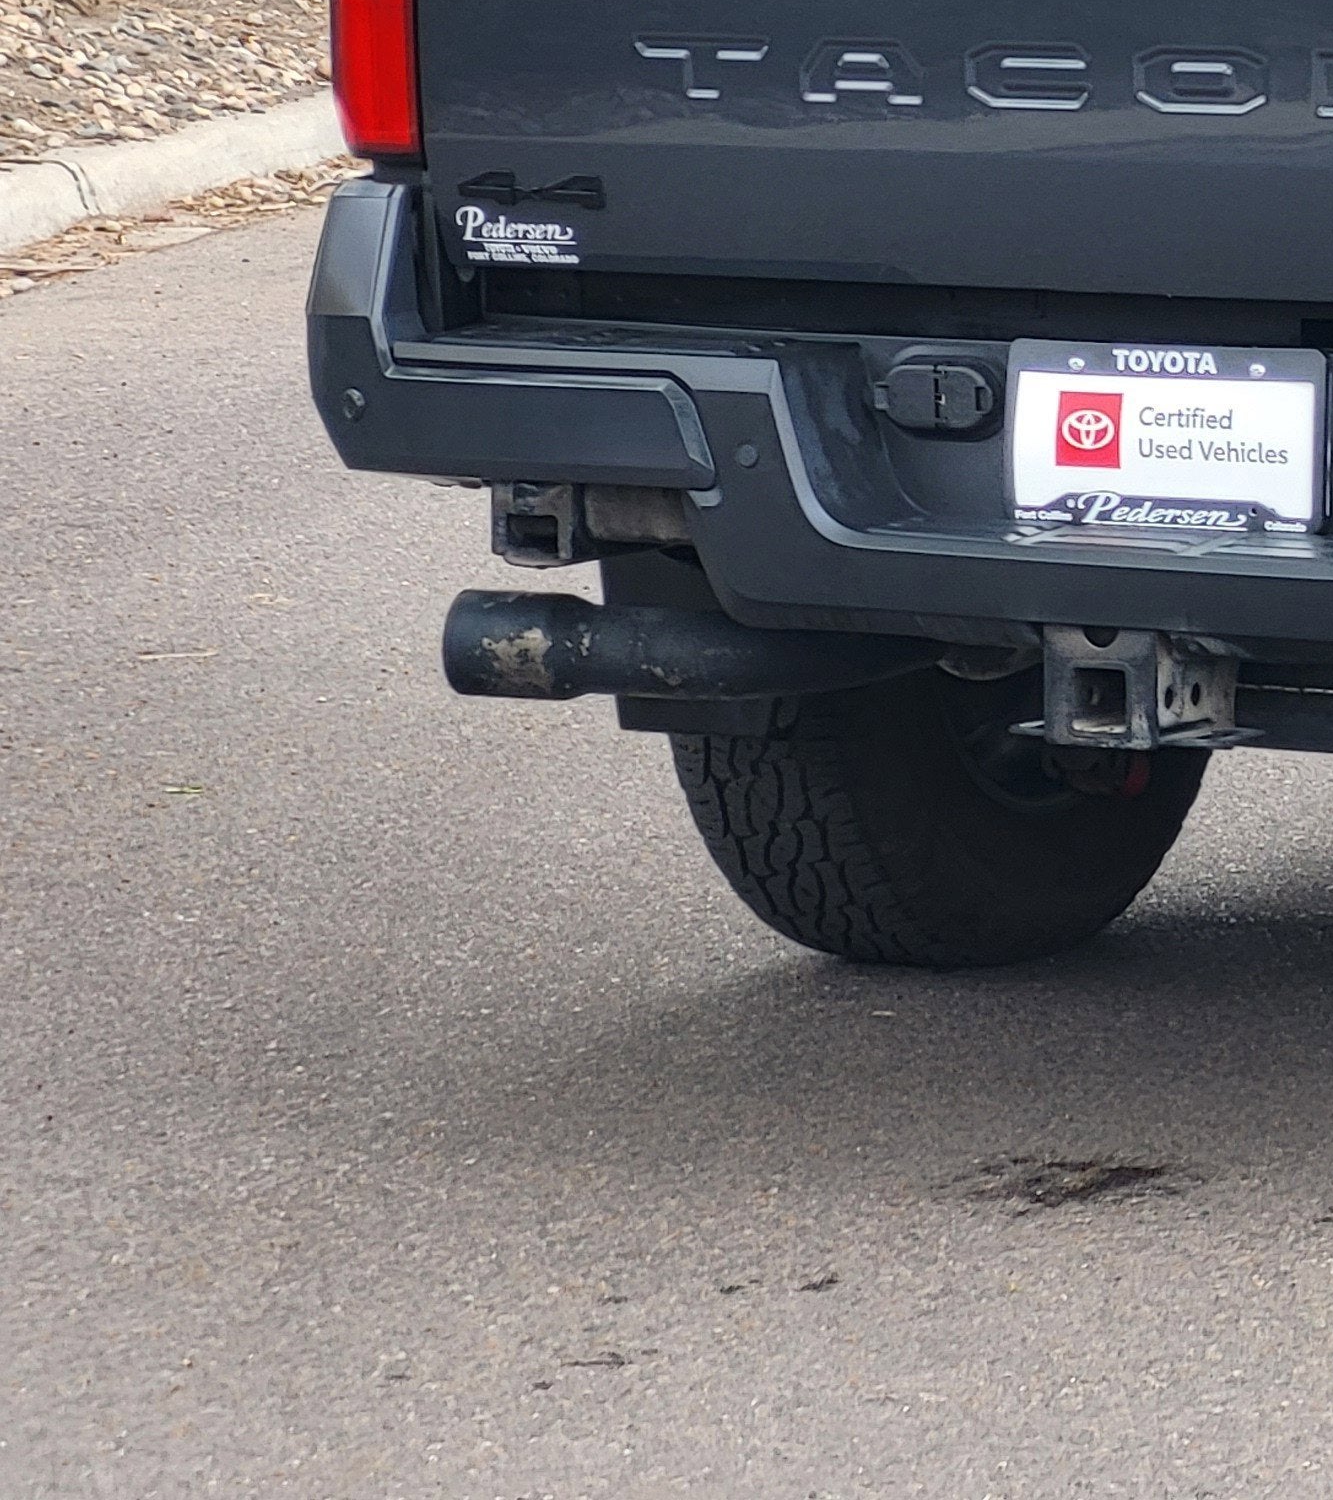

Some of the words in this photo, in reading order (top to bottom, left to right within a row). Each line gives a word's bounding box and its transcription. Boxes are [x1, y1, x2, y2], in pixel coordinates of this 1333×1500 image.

[455, 206, 577, 245] Pedersen
[1111, 348, 1219, 375] TOYOTA
[1138, 406, 1234, 430] Certified
[1137, 438, 1194, 461] Used
[1199, 440, 1290, 465] Vehicles
[1077, 491, 1249, 532] Pedersen
